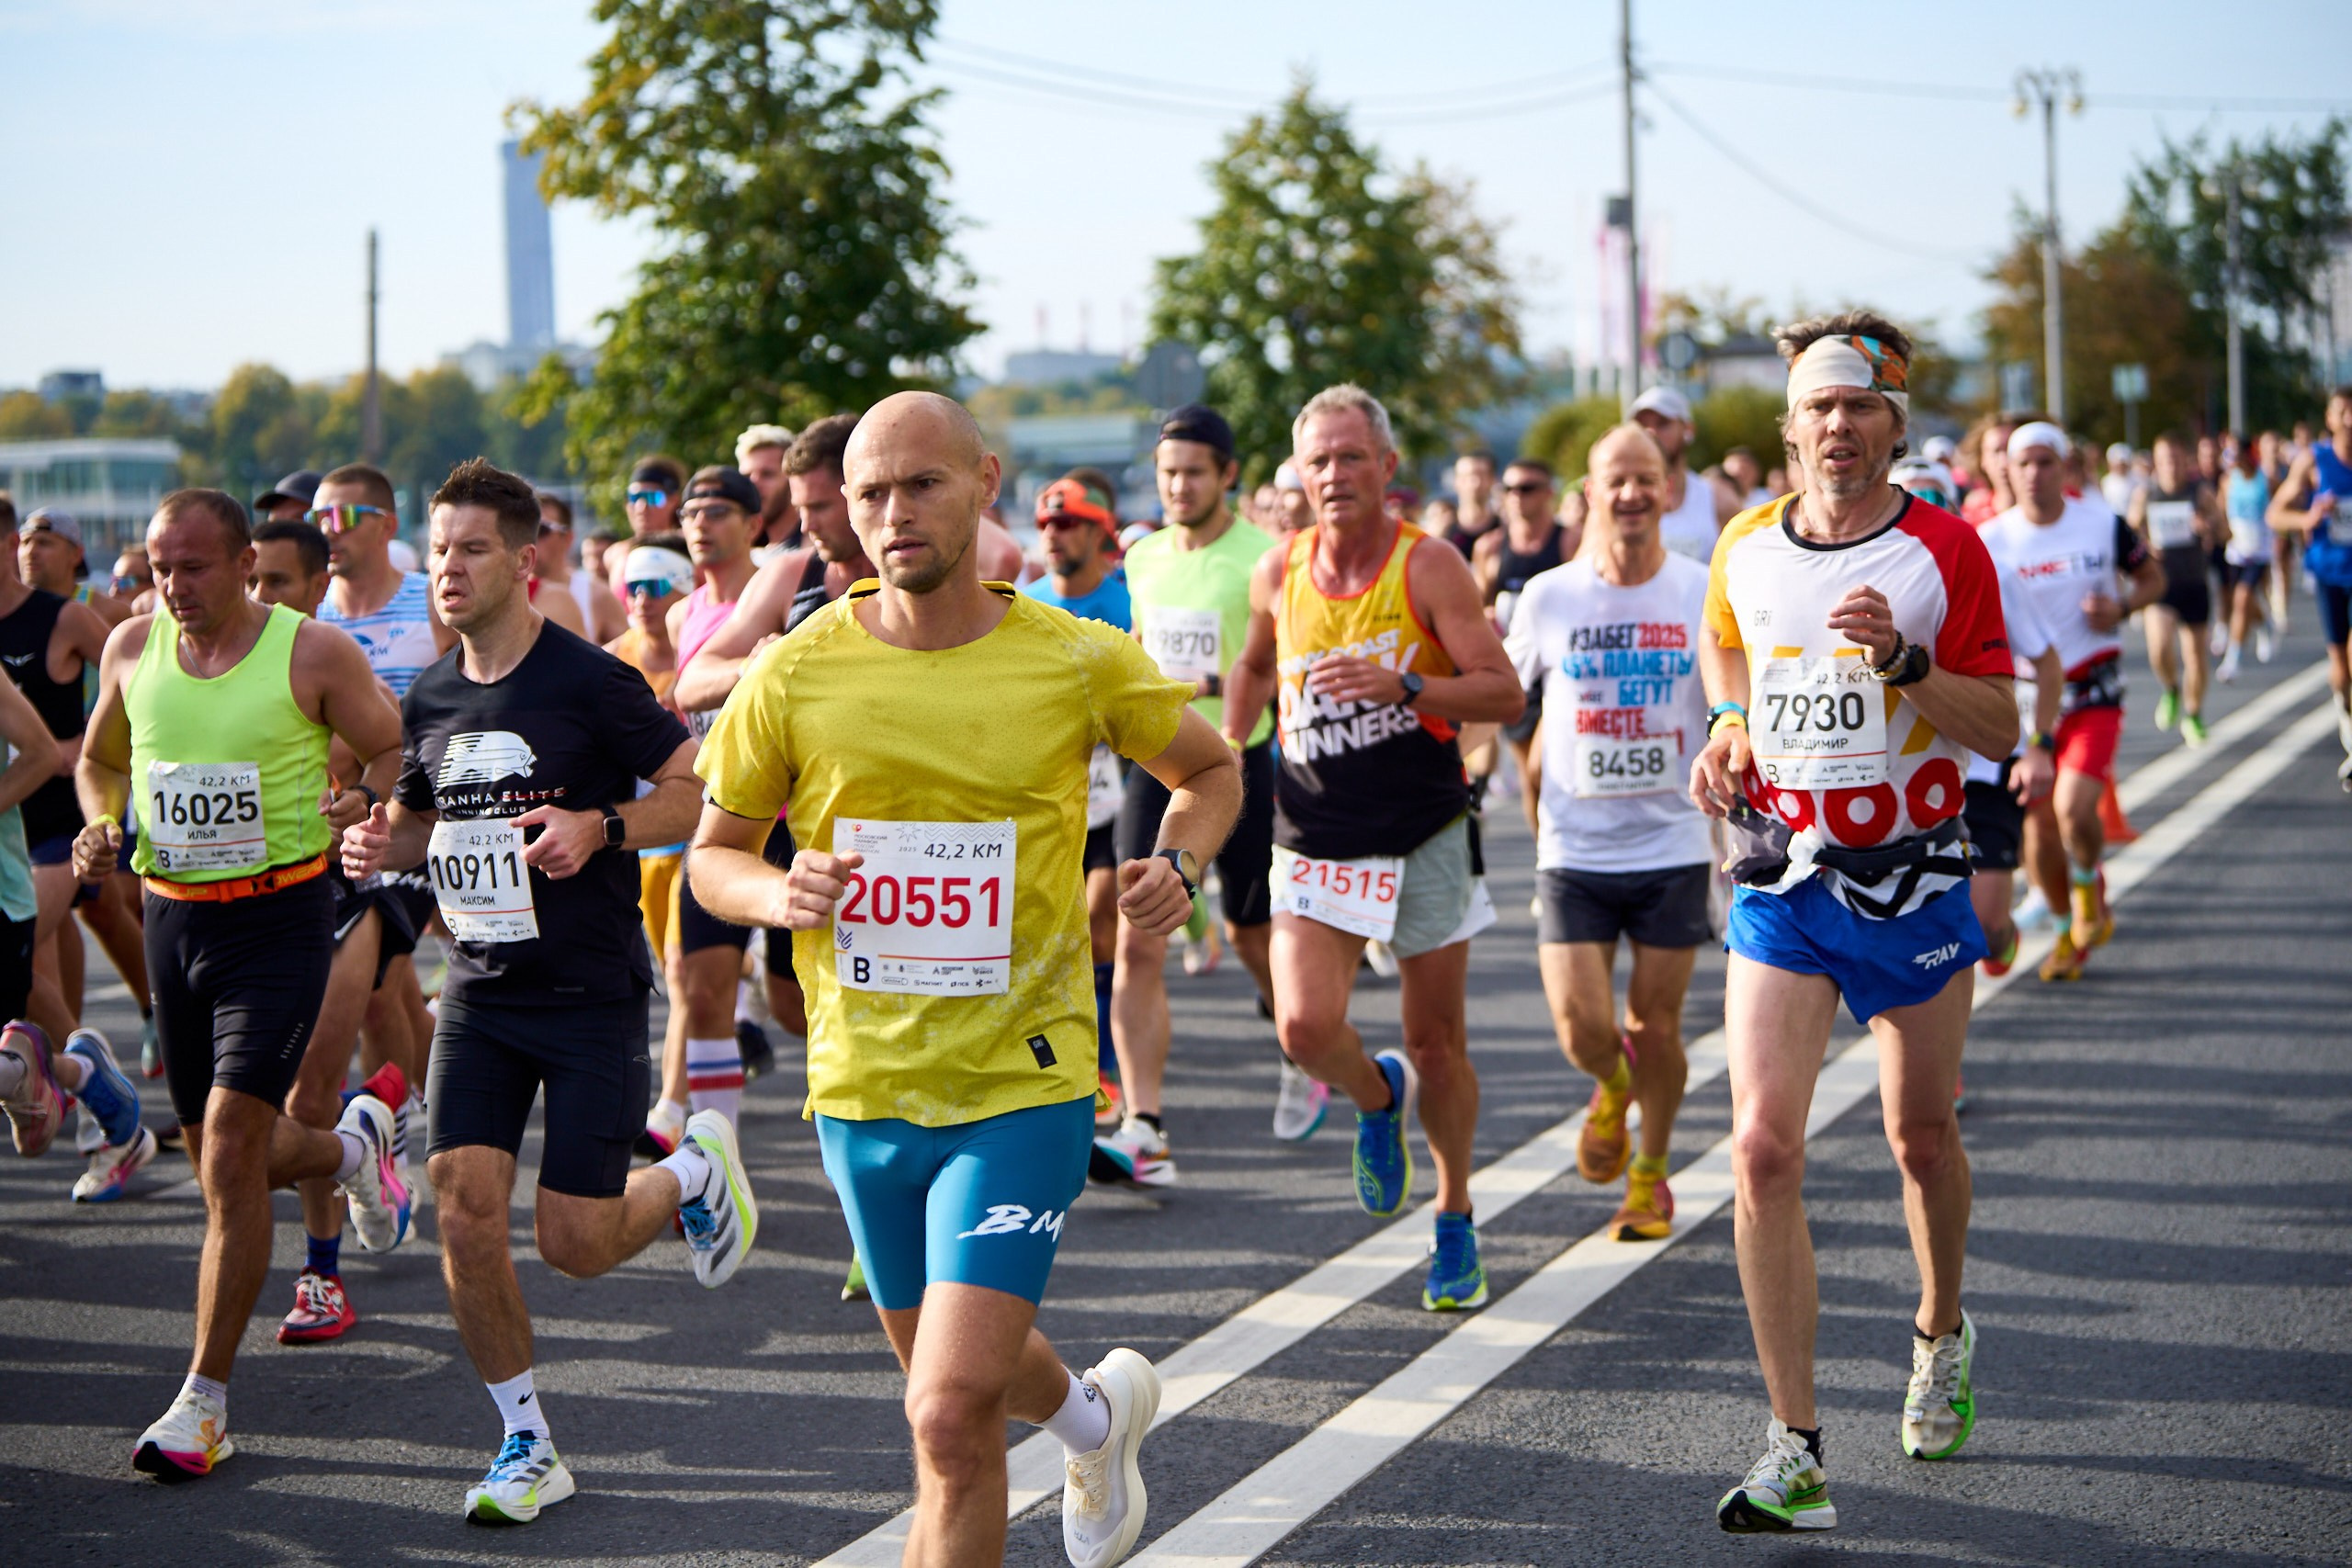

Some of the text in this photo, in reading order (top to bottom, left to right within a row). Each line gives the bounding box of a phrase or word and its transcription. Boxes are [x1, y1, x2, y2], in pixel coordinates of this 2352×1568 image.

[1618, 679, 1672, 706] БЕГУТ
[1767, 692, 1864, 732] 7930
[1282, 703, 1419, 765] UNNERS
[1782, 738, 1849, 750] ВЛАДИМИР
[1589, 747, 1665, 777] 8458
[199, 776, 226, 787] 42,2
[502, 786, 567, 802] ELITE
[153, 790, 258, 826] 16025
[494, 807, 526, 815] CLUB
[187, 830, 218, 840] ИЛЬЯ
[469, 834, 491, 846] 42,2
[924, 843, 1002, 861] 42,2 KM
[431, 851, 519, 891] 10911
[1290, 858, 1396, 903] 21515
[460, 896, 495, 907] МАКСИМ
[840, 872, 1000, 929] 20551
[854, 956, 870, 984] B
[956, 1204, 1065, 1243] BM
